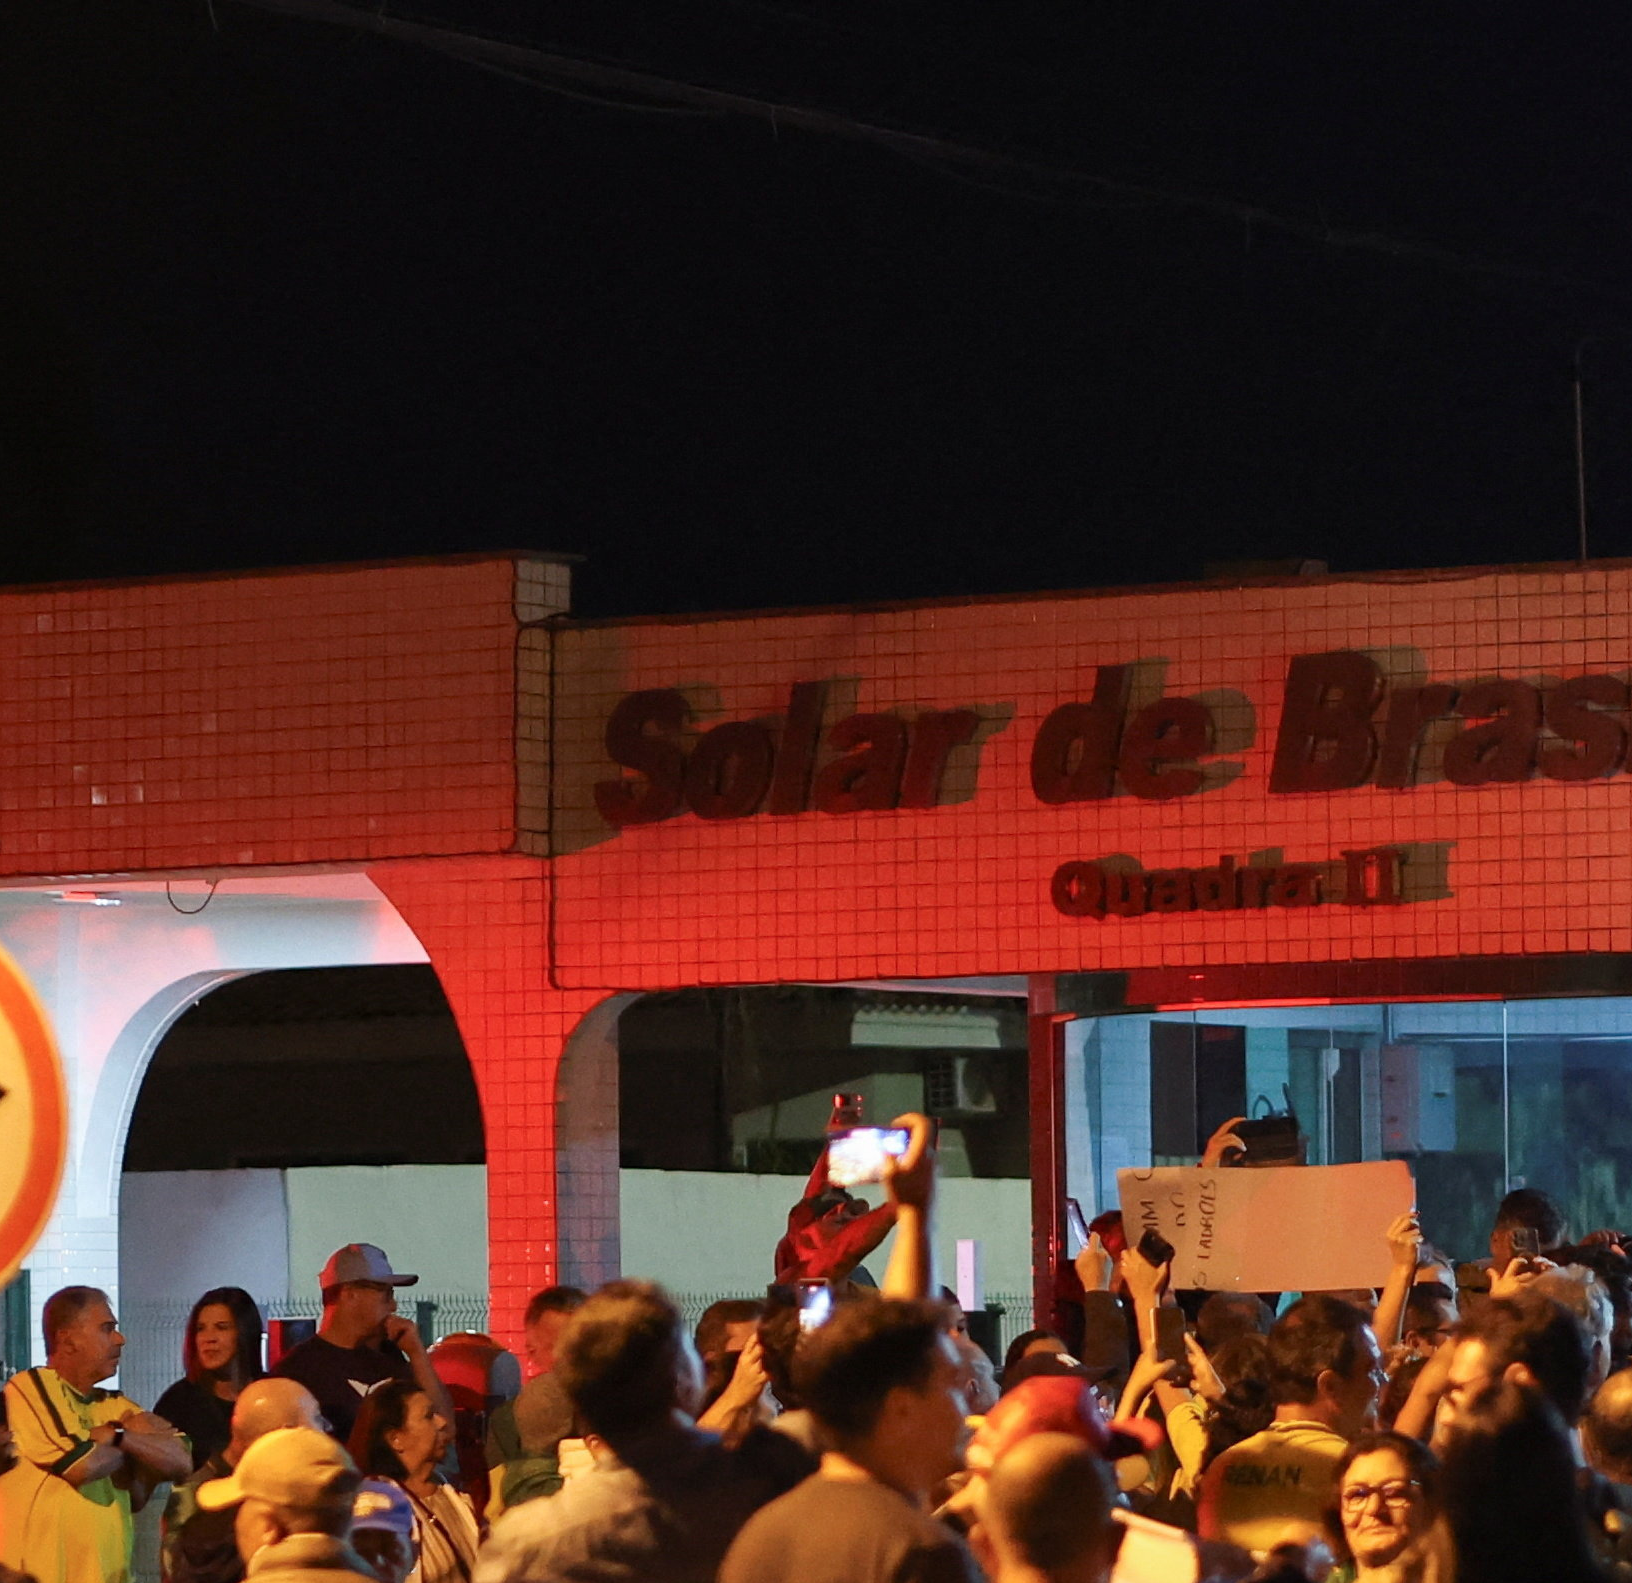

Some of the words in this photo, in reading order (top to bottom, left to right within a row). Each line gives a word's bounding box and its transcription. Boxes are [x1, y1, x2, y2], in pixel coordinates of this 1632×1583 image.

[594, 680, 980, 827] Solar
[1030, 664, 1213, 805] de
[1050, 855, 1324, 921] Quadra
[1340, 849, 1409, 908] II
